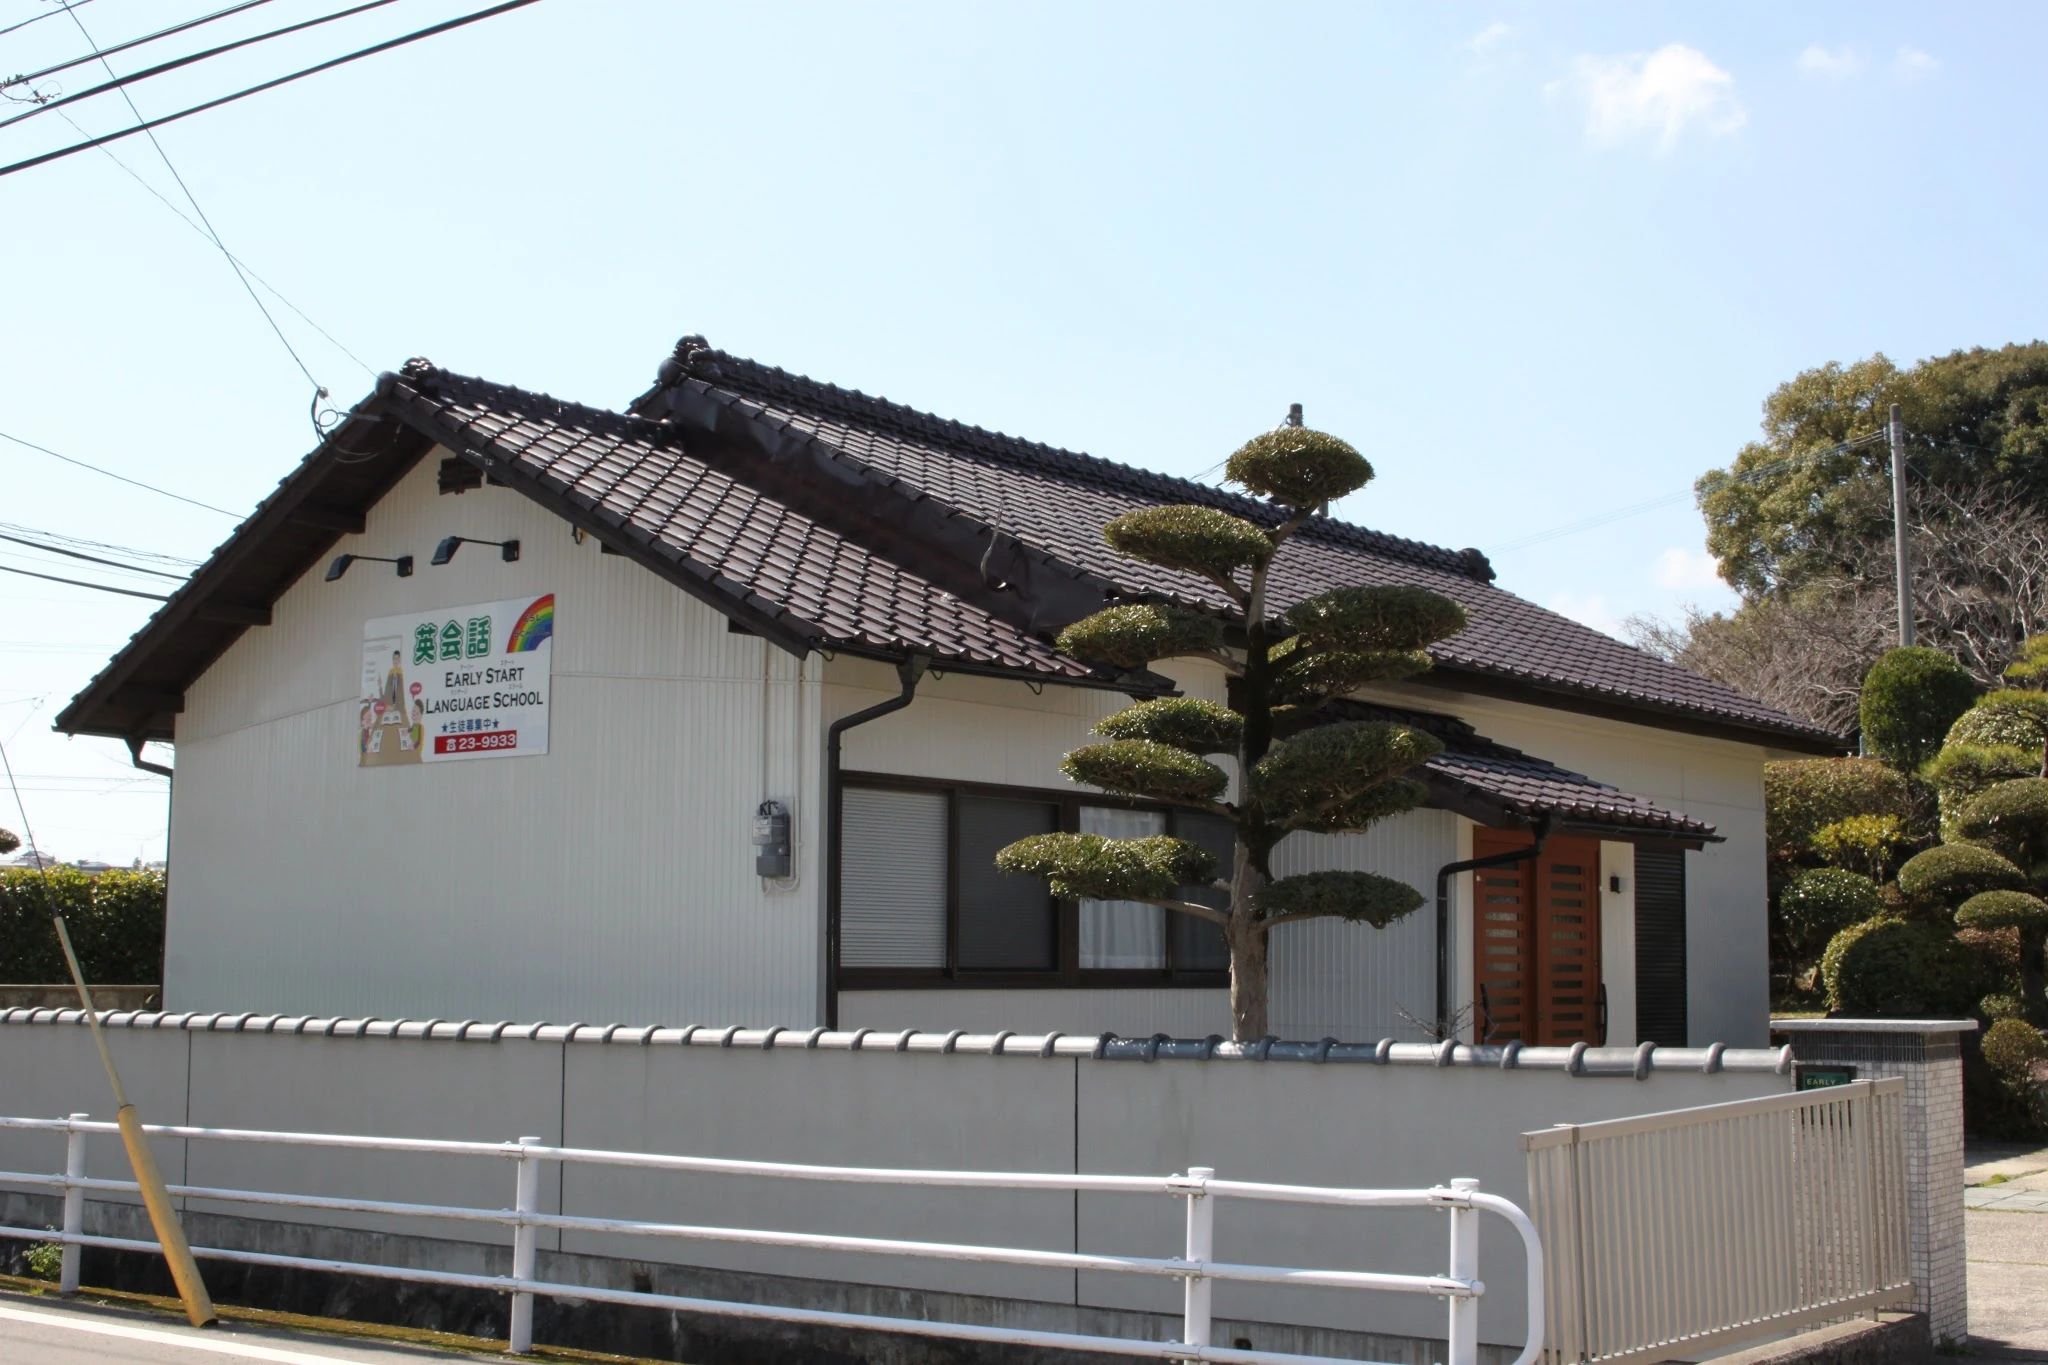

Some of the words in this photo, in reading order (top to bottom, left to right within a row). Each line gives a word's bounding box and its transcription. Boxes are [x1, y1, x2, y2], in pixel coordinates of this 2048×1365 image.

[413, 615, 492, 666] 英会話
[445, 671, 483, 688] EARLY
[486, 667, 525, 684] START
[426, 695, 490, 714] LANGUAGE
[493, 691, 544, 709] SCHOOL
[458, 733, 517, 750] 23-9933
[1806, 1078, 1836, 1086] EARLY
